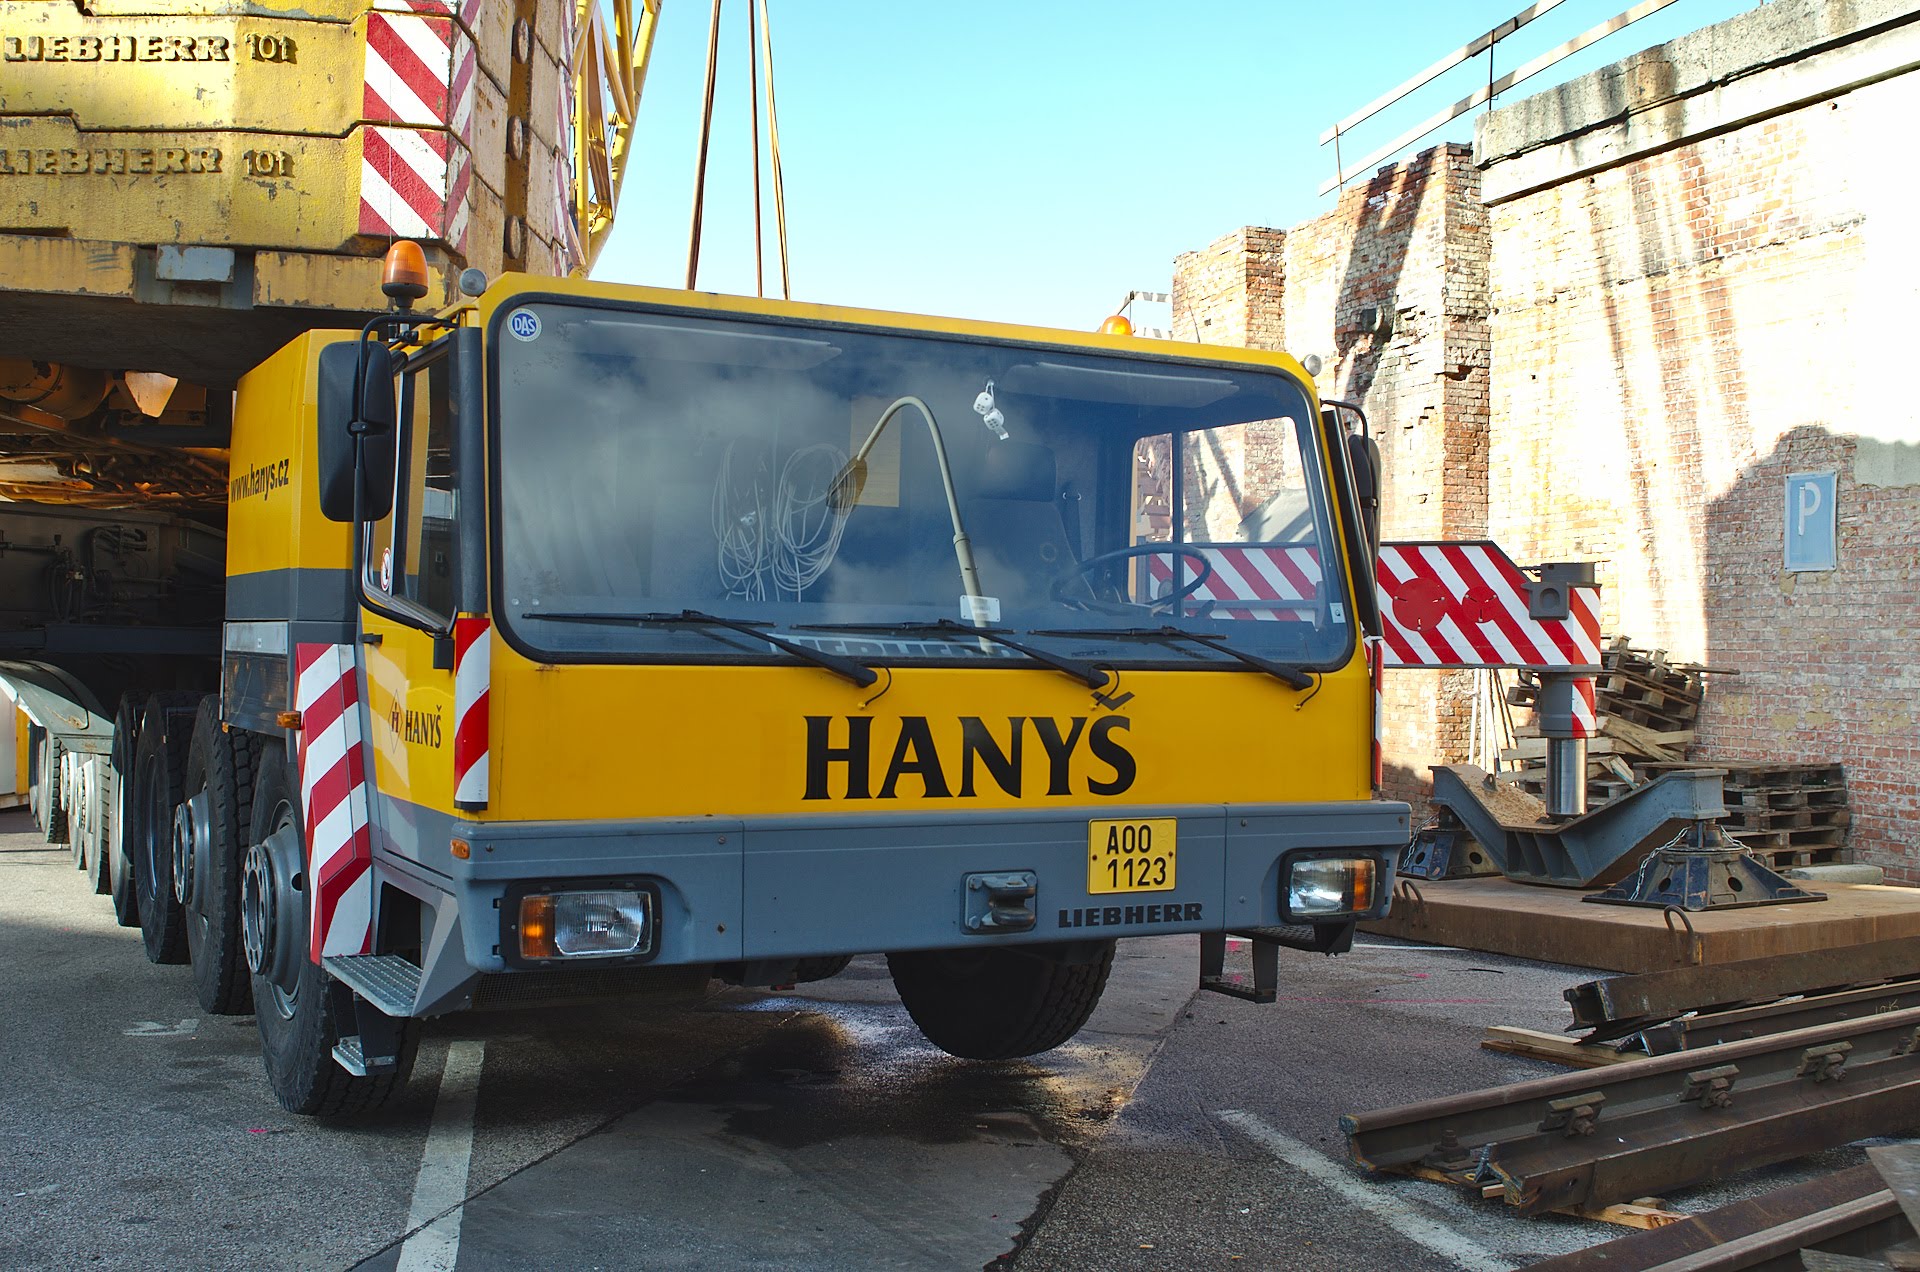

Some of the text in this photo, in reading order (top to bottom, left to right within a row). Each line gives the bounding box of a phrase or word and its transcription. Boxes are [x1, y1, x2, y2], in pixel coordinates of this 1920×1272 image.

[5, 36, 229, 62] LIEBHERR
[514, 316, 536, 335] DAS
[230, 458, 289, 503] www.hanys.cz
[1798, 481, 1821, 536] P
[405, 704, 442, 749] HANYŠ
[801, 690, 1137, 801] HANYŠ
[1107, 856, 1167, 888] 1123
[1058, 902, 1203, 929] LIEBHERR
